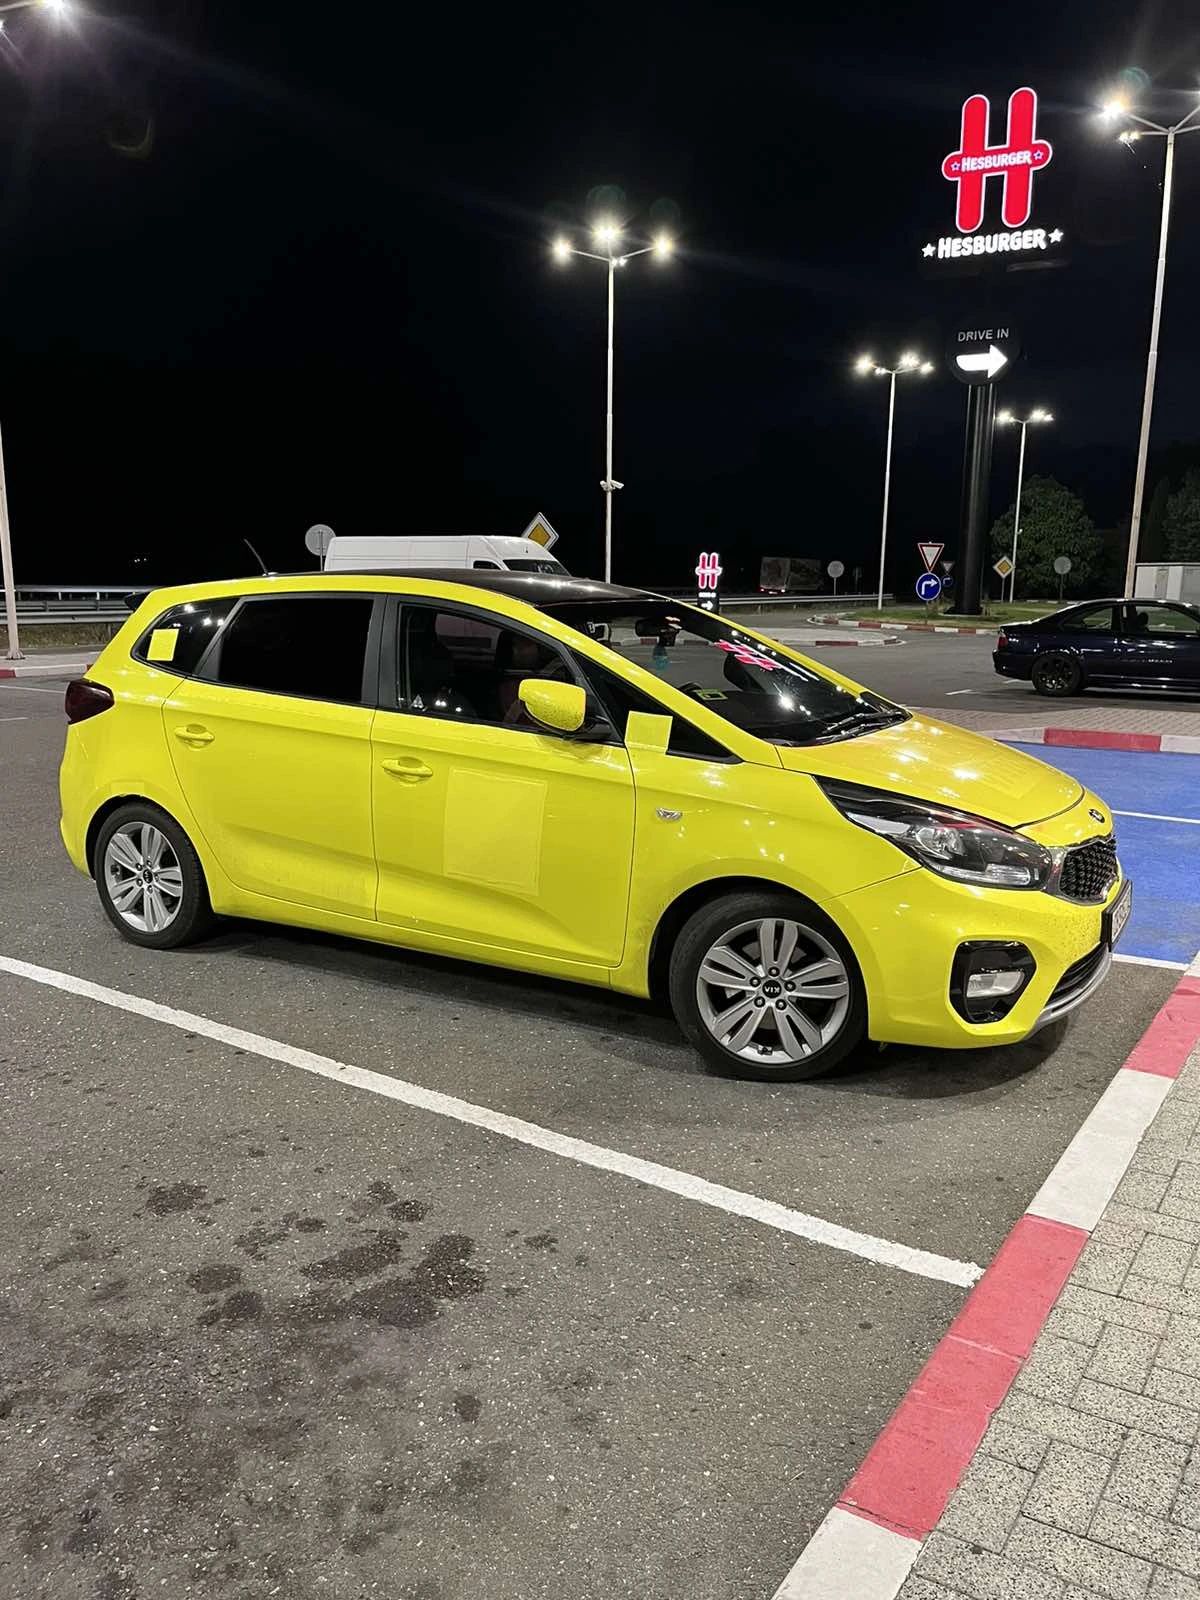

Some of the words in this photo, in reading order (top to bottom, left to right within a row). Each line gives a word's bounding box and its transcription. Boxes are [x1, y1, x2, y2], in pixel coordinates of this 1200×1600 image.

[961, 151, 1033, 172] HESBURGER
[938, 229, 1047, 259] HESBURGER
[958, 329, 993, 342] DRIVE
[997, 328, 1009, 339] IN
